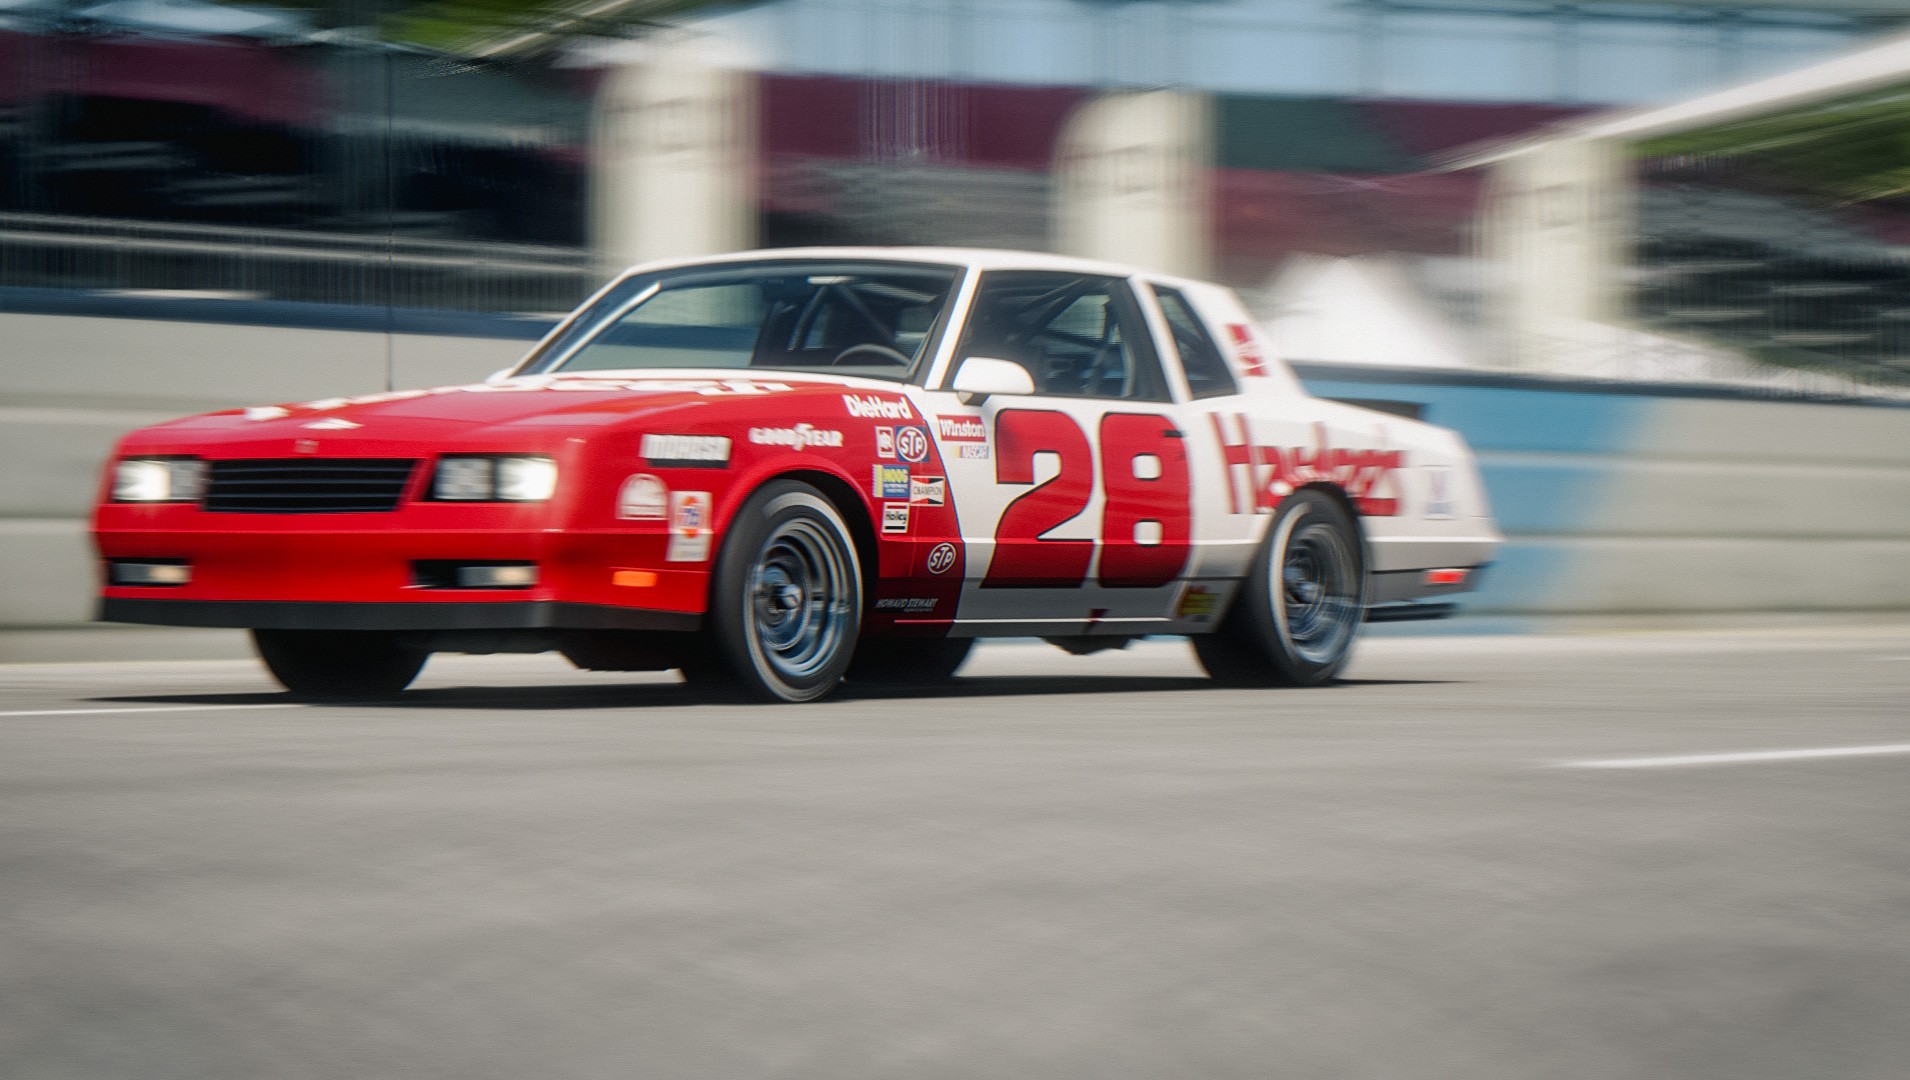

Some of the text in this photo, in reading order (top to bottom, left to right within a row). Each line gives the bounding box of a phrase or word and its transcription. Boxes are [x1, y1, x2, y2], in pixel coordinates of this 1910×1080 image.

[842, 394, 913, 419] DieHard
[749, 423, 844, 451] GOODYEAR
[939, 419, 985, 437] Winston
[900, 430, 923, 456] STP
[913, 486, 942, 496] CHAMPION
[979, 408, 1193, 589] 28
[886, 511, 907, 525] Holley
[875, 598, 938, 608] HOWARD STEWART
